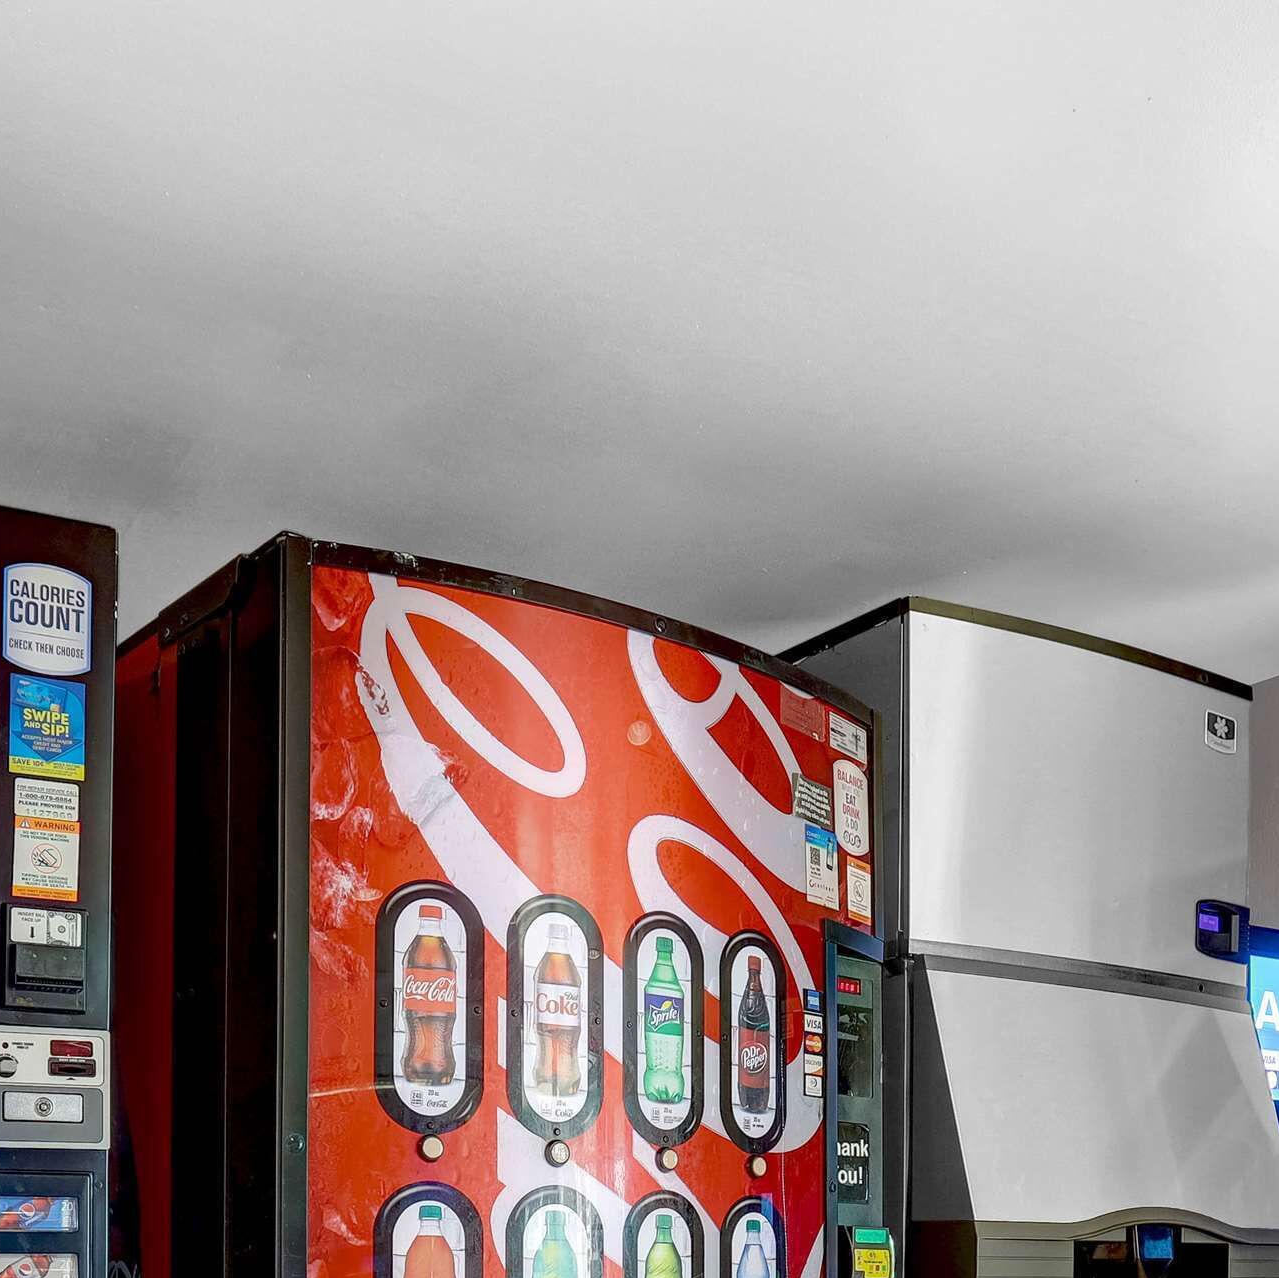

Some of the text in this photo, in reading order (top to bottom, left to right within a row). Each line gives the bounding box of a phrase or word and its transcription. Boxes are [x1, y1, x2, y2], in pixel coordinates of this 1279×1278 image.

[10, 579, 85, 607] CALORIES
[10, 599, 84, 632] COUNT
[9, 638, 84, 659] CHECK THEN CHOOSE
[23, 708, 69, 725] SWIPE
[24, 721, 69, 737] AND SIP!
[12, 758, 31, 766] SAVE
[837, 767, 864, 791] BALANCE
[845, 792, 856, 807] EAT
[842, 803, 860, 820] DRINK
[34, 821, 76, 832] WARNING
[404, 974, 455, 1002] Coca-Cola
[536, 992, 579, 1016] Coke
[650, 1008, 678, 1027] Sprite
[806, 1019, 822, 1030] VISA
[743, 1048, 767, 1069] Pepper
[750, 1046, 761, 1056] Dr
[836, 1165, 863, 1185] ou!
